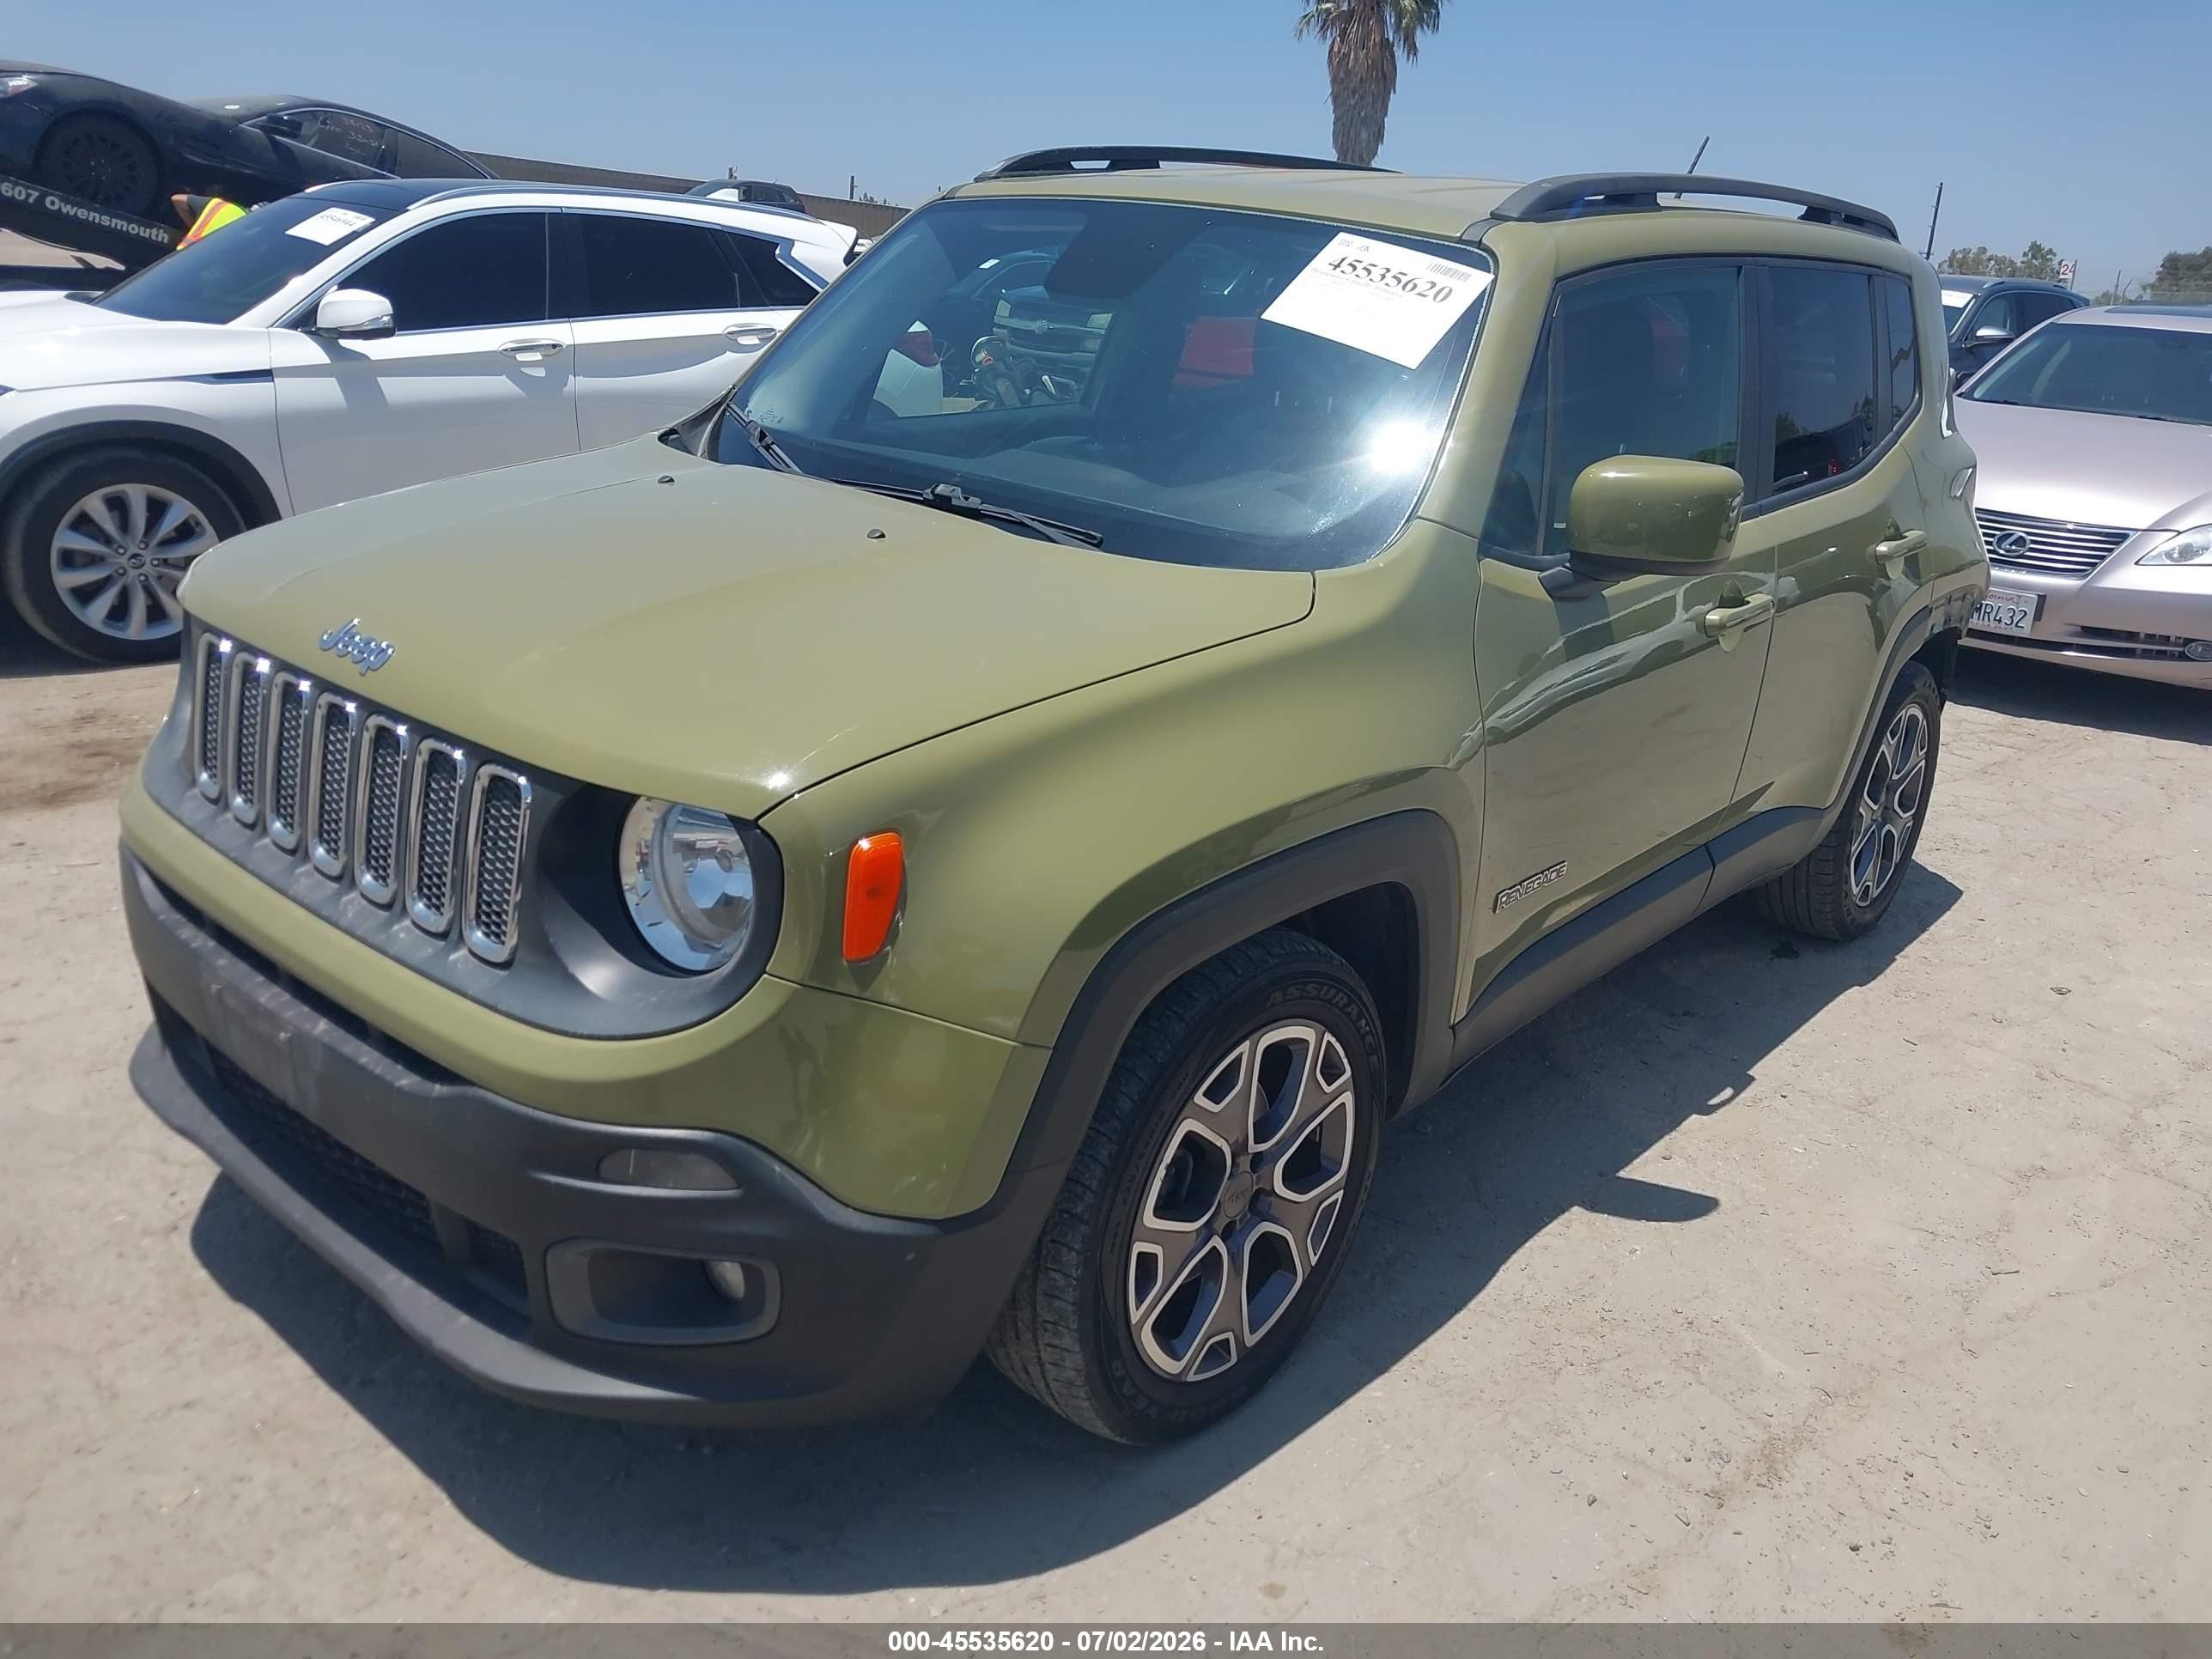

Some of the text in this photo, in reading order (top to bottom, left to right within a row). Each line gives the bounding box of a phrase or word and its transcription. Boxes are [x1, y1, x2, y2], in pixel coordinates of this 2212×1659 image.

[0, 181, 169, 244] 607 Owensmouth
[1328, 256, 1453, 303] 45535620
[319, 617, 395, 677] Jeep
[1494, 860, 1568, 913] RENEGADE
[1265, 983, 1381, 1073] ASSURANCE
